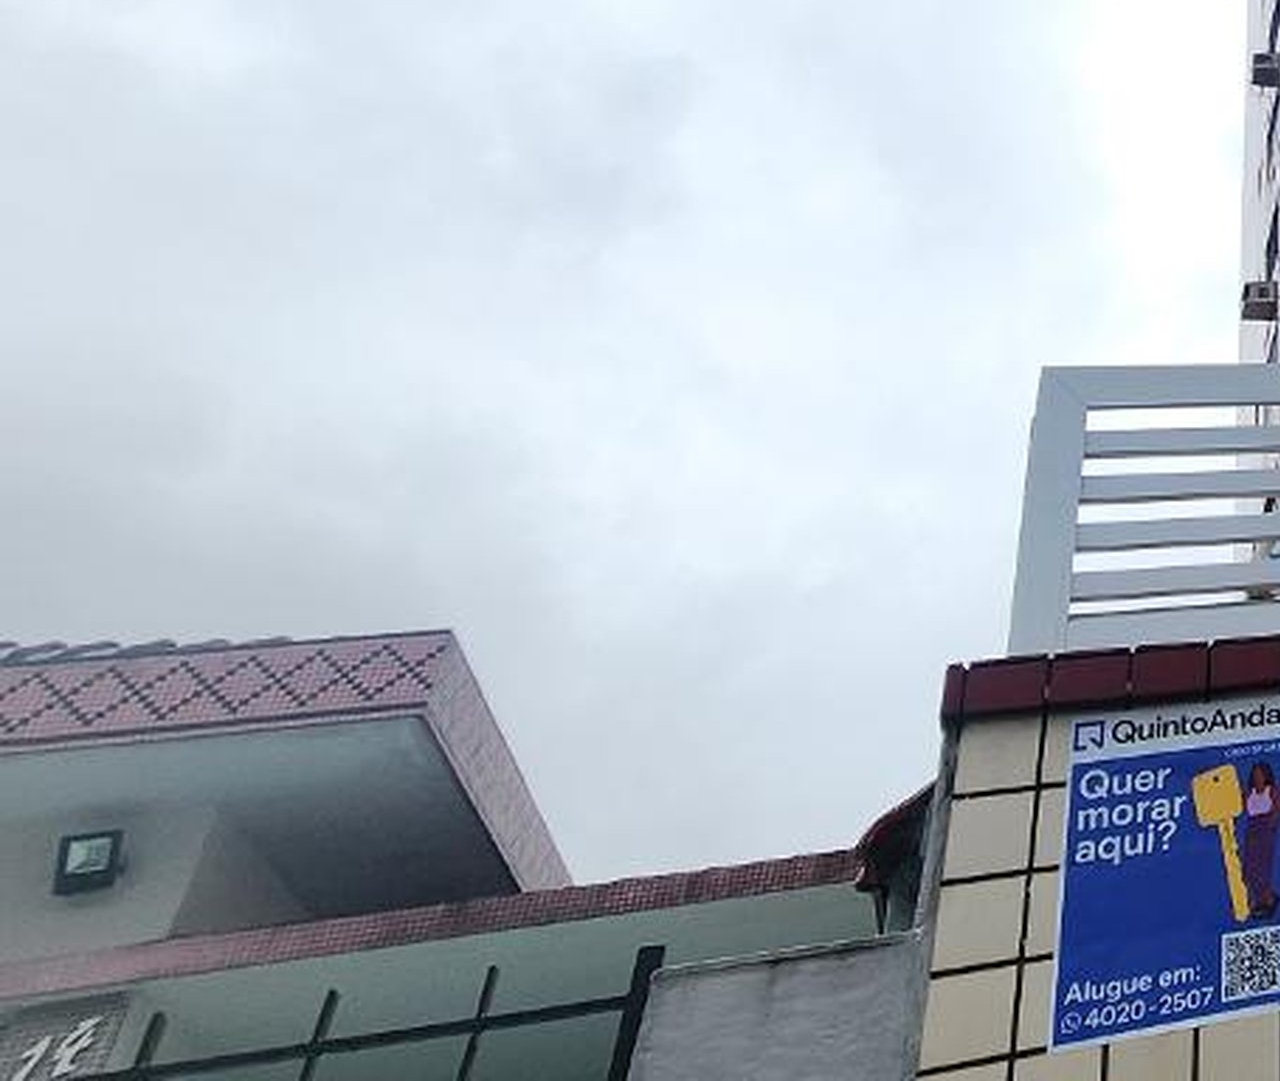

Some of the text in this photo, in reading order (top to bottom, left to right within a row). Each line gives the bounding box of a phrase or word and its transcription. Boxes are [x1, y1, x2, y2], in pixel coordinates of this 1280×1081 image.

[1079, 766, 1172, 799] Quer
[1077, 793, 1188, 831] morar
[1074, 821, 1177, 865] aqui?
[1063, 965, 1202, 1006] Alugue em:
[1083, 986, 1215, 1029] 4020-2507
